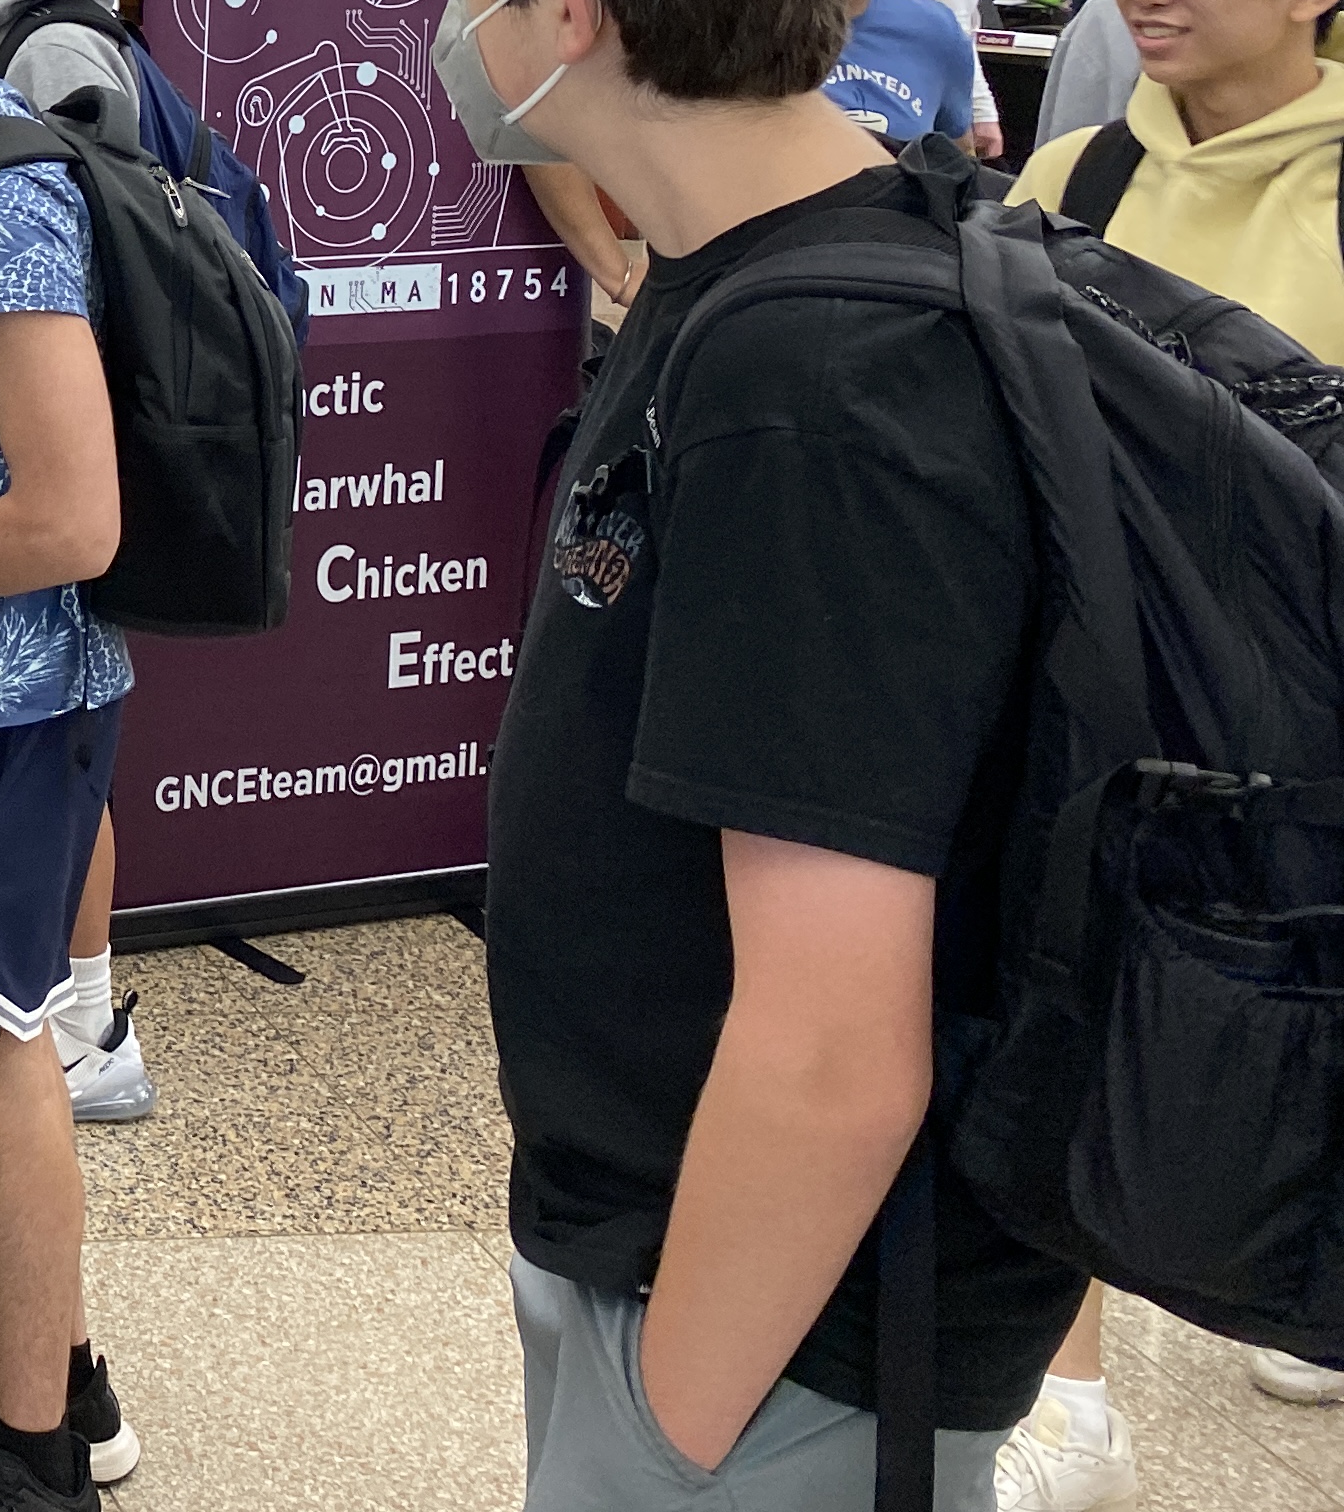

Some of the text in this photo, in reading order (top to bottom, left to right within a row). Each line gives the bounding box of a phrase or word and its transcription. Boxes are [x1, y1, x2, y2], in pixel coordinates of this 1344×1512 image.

[823, 63, 912, 101] CINATED
[446, 265, 570, 306] 18754
[302, 370, 386, 419] ctic
[316, 543, 488, 603] Chicken
[387, 630, 514, 689] Effect
[155, 741, 488, 813] GNCEteam@gmail.
